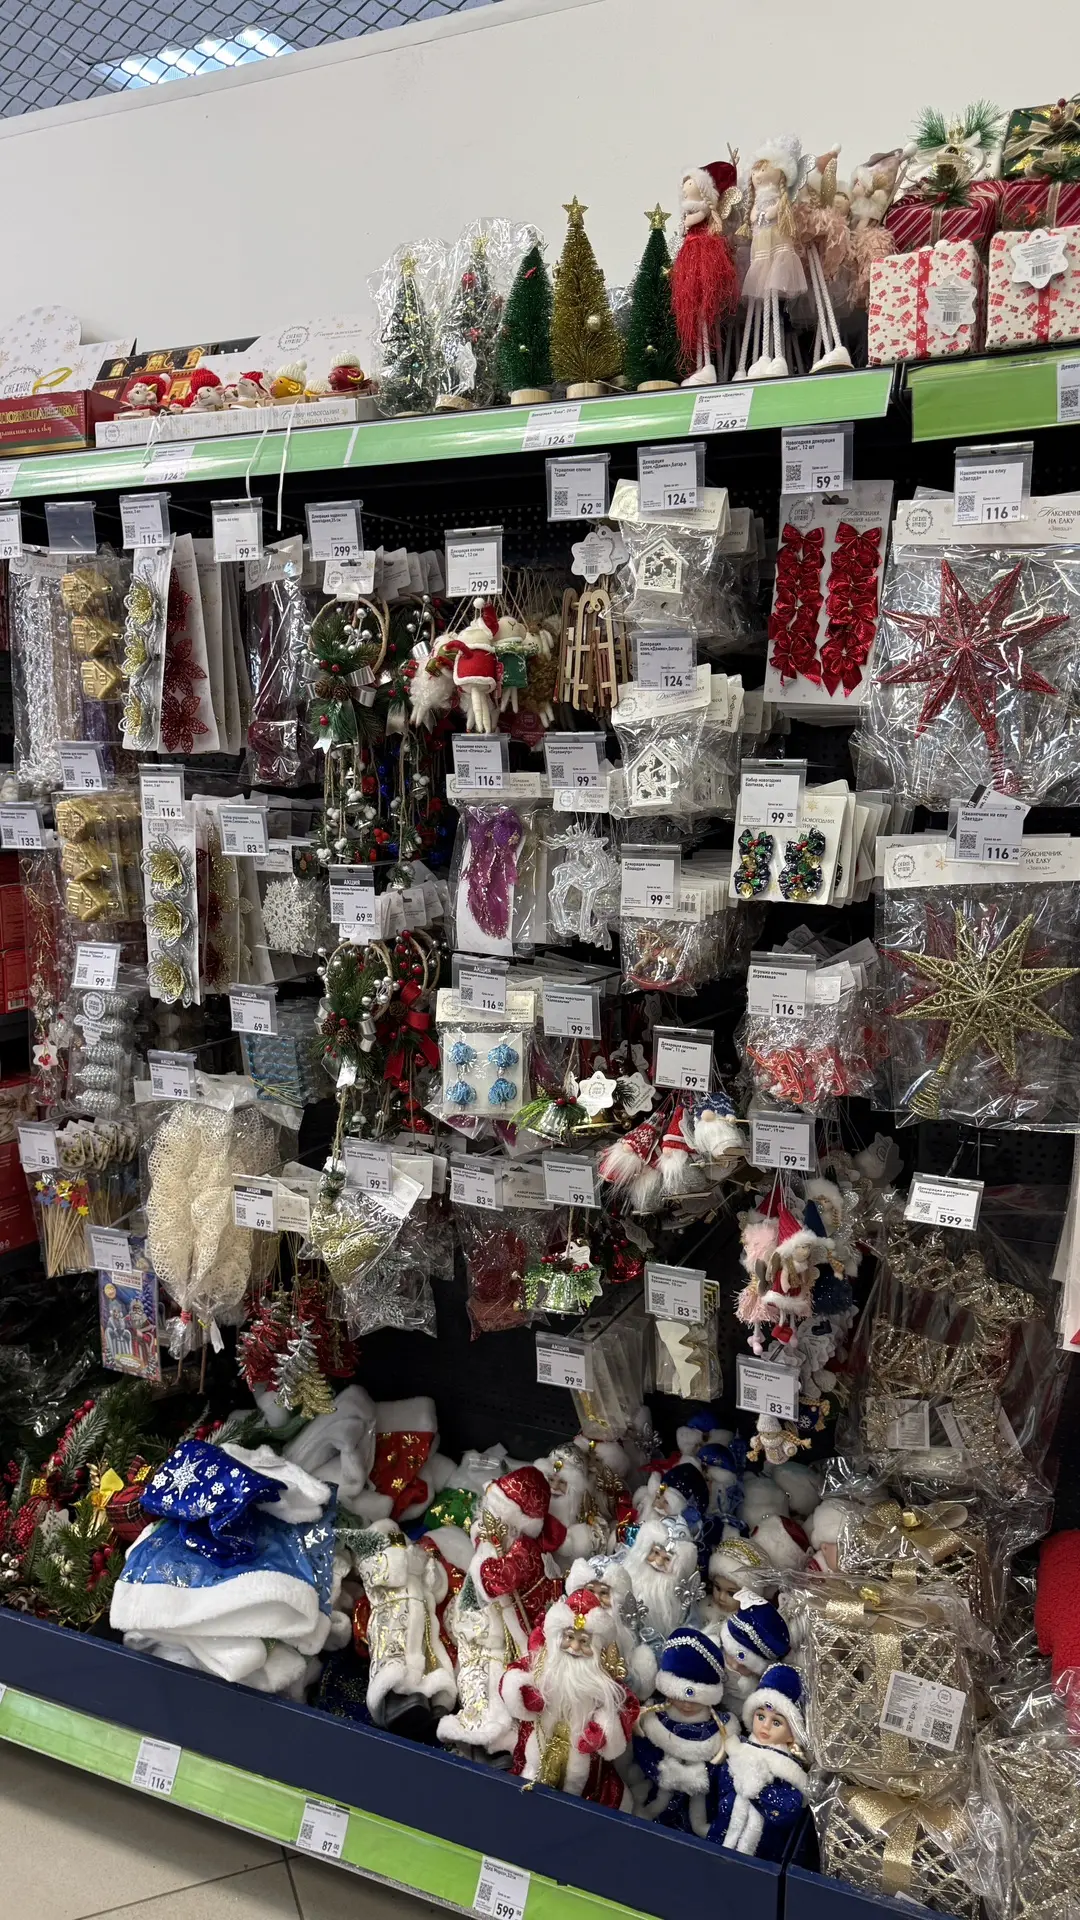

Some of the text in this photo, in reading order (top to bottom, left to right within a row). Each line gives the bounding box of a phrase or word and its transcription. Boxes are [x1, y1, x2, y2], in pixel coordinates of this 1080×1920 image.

[4, 381, 31, 395] СНЕЖНОЕ
[716, 420, 737, 430] 249
[548, 435, 565, 445] 124
[816, 476, 831, 489] 59
[668, 493, 687, 506] 124
[580, 503, 593, 514] 62
[986, 506, 1008, 520] 116
[142, 534, 157, 545] 116
[4, 546, 12, 557] 62
[239, 547, 249, 558] 99
[334, 546, 350, 557] 299
[471, 581, 489, 592] 299
[664, 675, 683, 687] 124
[84, 779, 94, 787] 59
[478, 775, 494, 786] 116
[577, 776, 589, 786] 99
[161, 808, 176, 817] 116
[771, 812, 785, 823] 99
[21, 837, 35, 847] 133
[247, 844, 258, 853] 83
[987, 847, 1009, 859] 116
[650, 894, 663, 904] 99
[356, 913, 366, 922] 69
[95, 977, 105, 986] 99
[482, 999, 496, 1010] 116
[776, 1003, 794, 1015] 116
[254, 1022, 262, 1031] 69
[571, 1024, 583, 1035] 99
[685, 1075, 698, 1087] 99
[173, 1088, 182, 1096] 99
[41, 1155, 50, 1164] 83
[784, 1155, 797, 1166] 99
[370, 1179, 380, 1189] 99
[476, 1196, 486, 1205] 83
[573, 1193, 584, 1204] 99
[256, 1218, 265, 1227] 69
[939, 1214, 962, 1225] 599
[115, 1261, 125, 1270] 99
[677, 1306, 690, 1317] 83
[564, 1375, 575, 1385] 99
[770, 1402, 782, 1413] 83
[151, 1776, 165, 1790] 116
[322, 1840, 333, 1852] 87
[496, 1902, 514, 1919] 599
